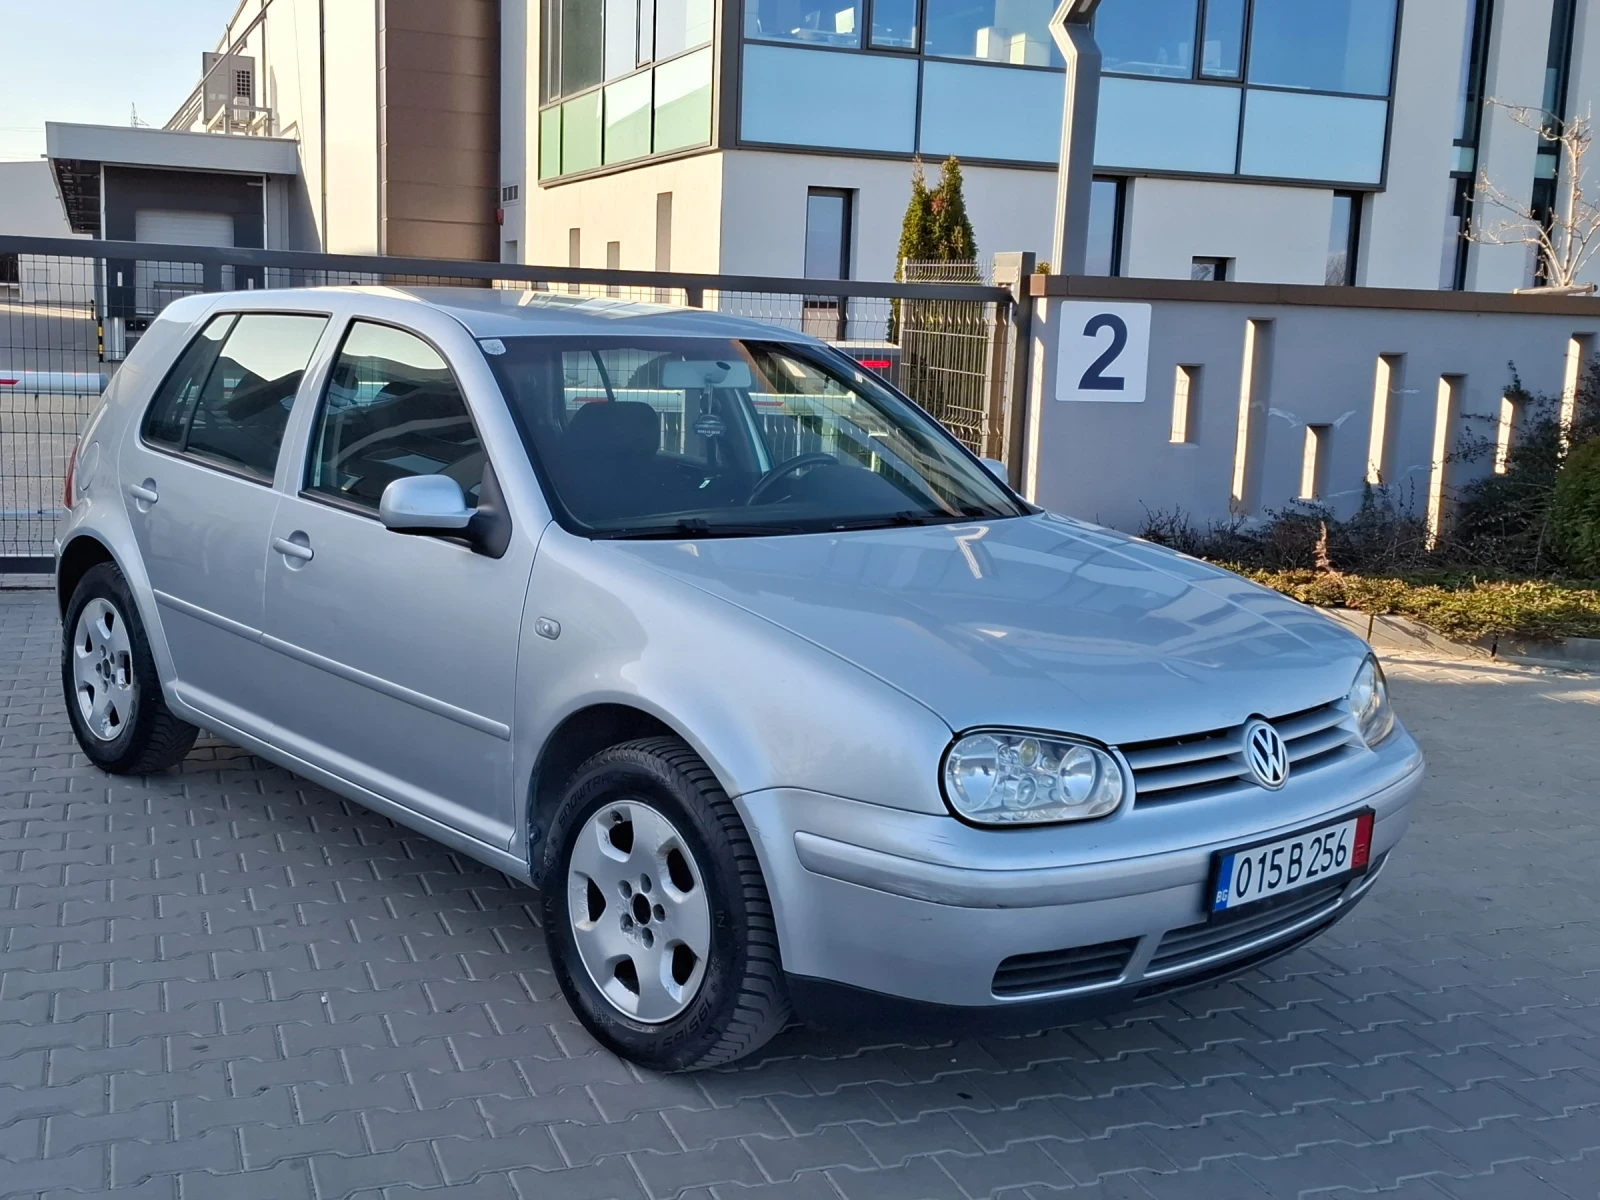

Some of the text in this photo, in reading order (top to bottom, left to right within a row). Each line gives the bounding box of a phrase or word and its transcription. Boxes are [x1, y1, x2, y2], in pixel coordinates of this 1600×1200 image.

[1078, 313, 1127, 390] 2
[1248, 723, 1287, 787] VW
[1215, 888, 1228, 903] BG
[1236, 828, 1347, 898] 015B256
